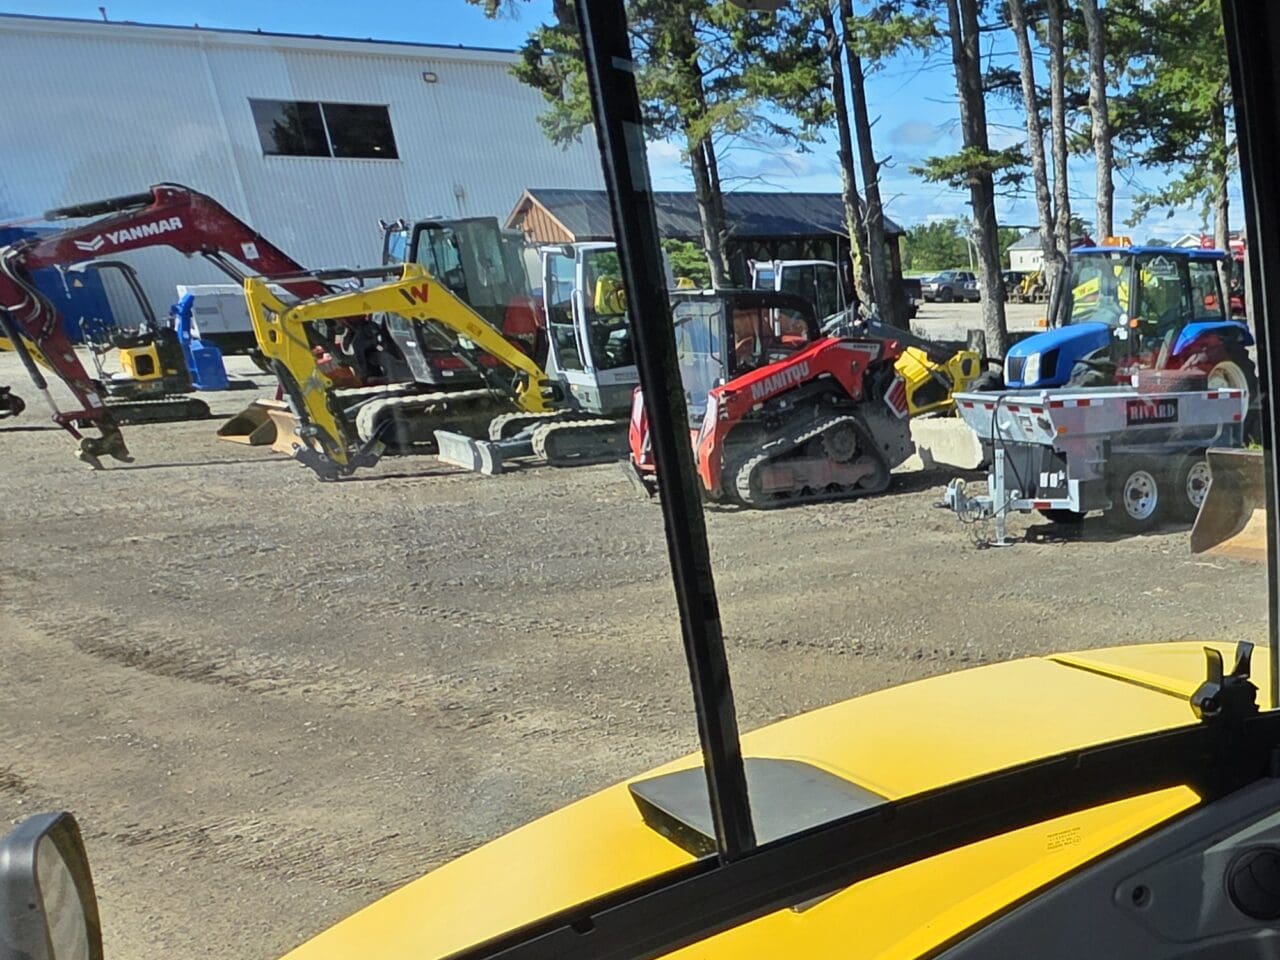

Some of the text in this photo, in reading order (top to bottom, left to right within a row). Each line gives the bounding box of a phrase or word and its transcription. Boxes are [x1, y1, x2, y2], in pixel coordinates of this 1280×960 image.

[105, 217, 183, 245] YANMAR
[751, 361, 810, 399] MANITOU
[1130, 403, 1175, 419] RIVARD
